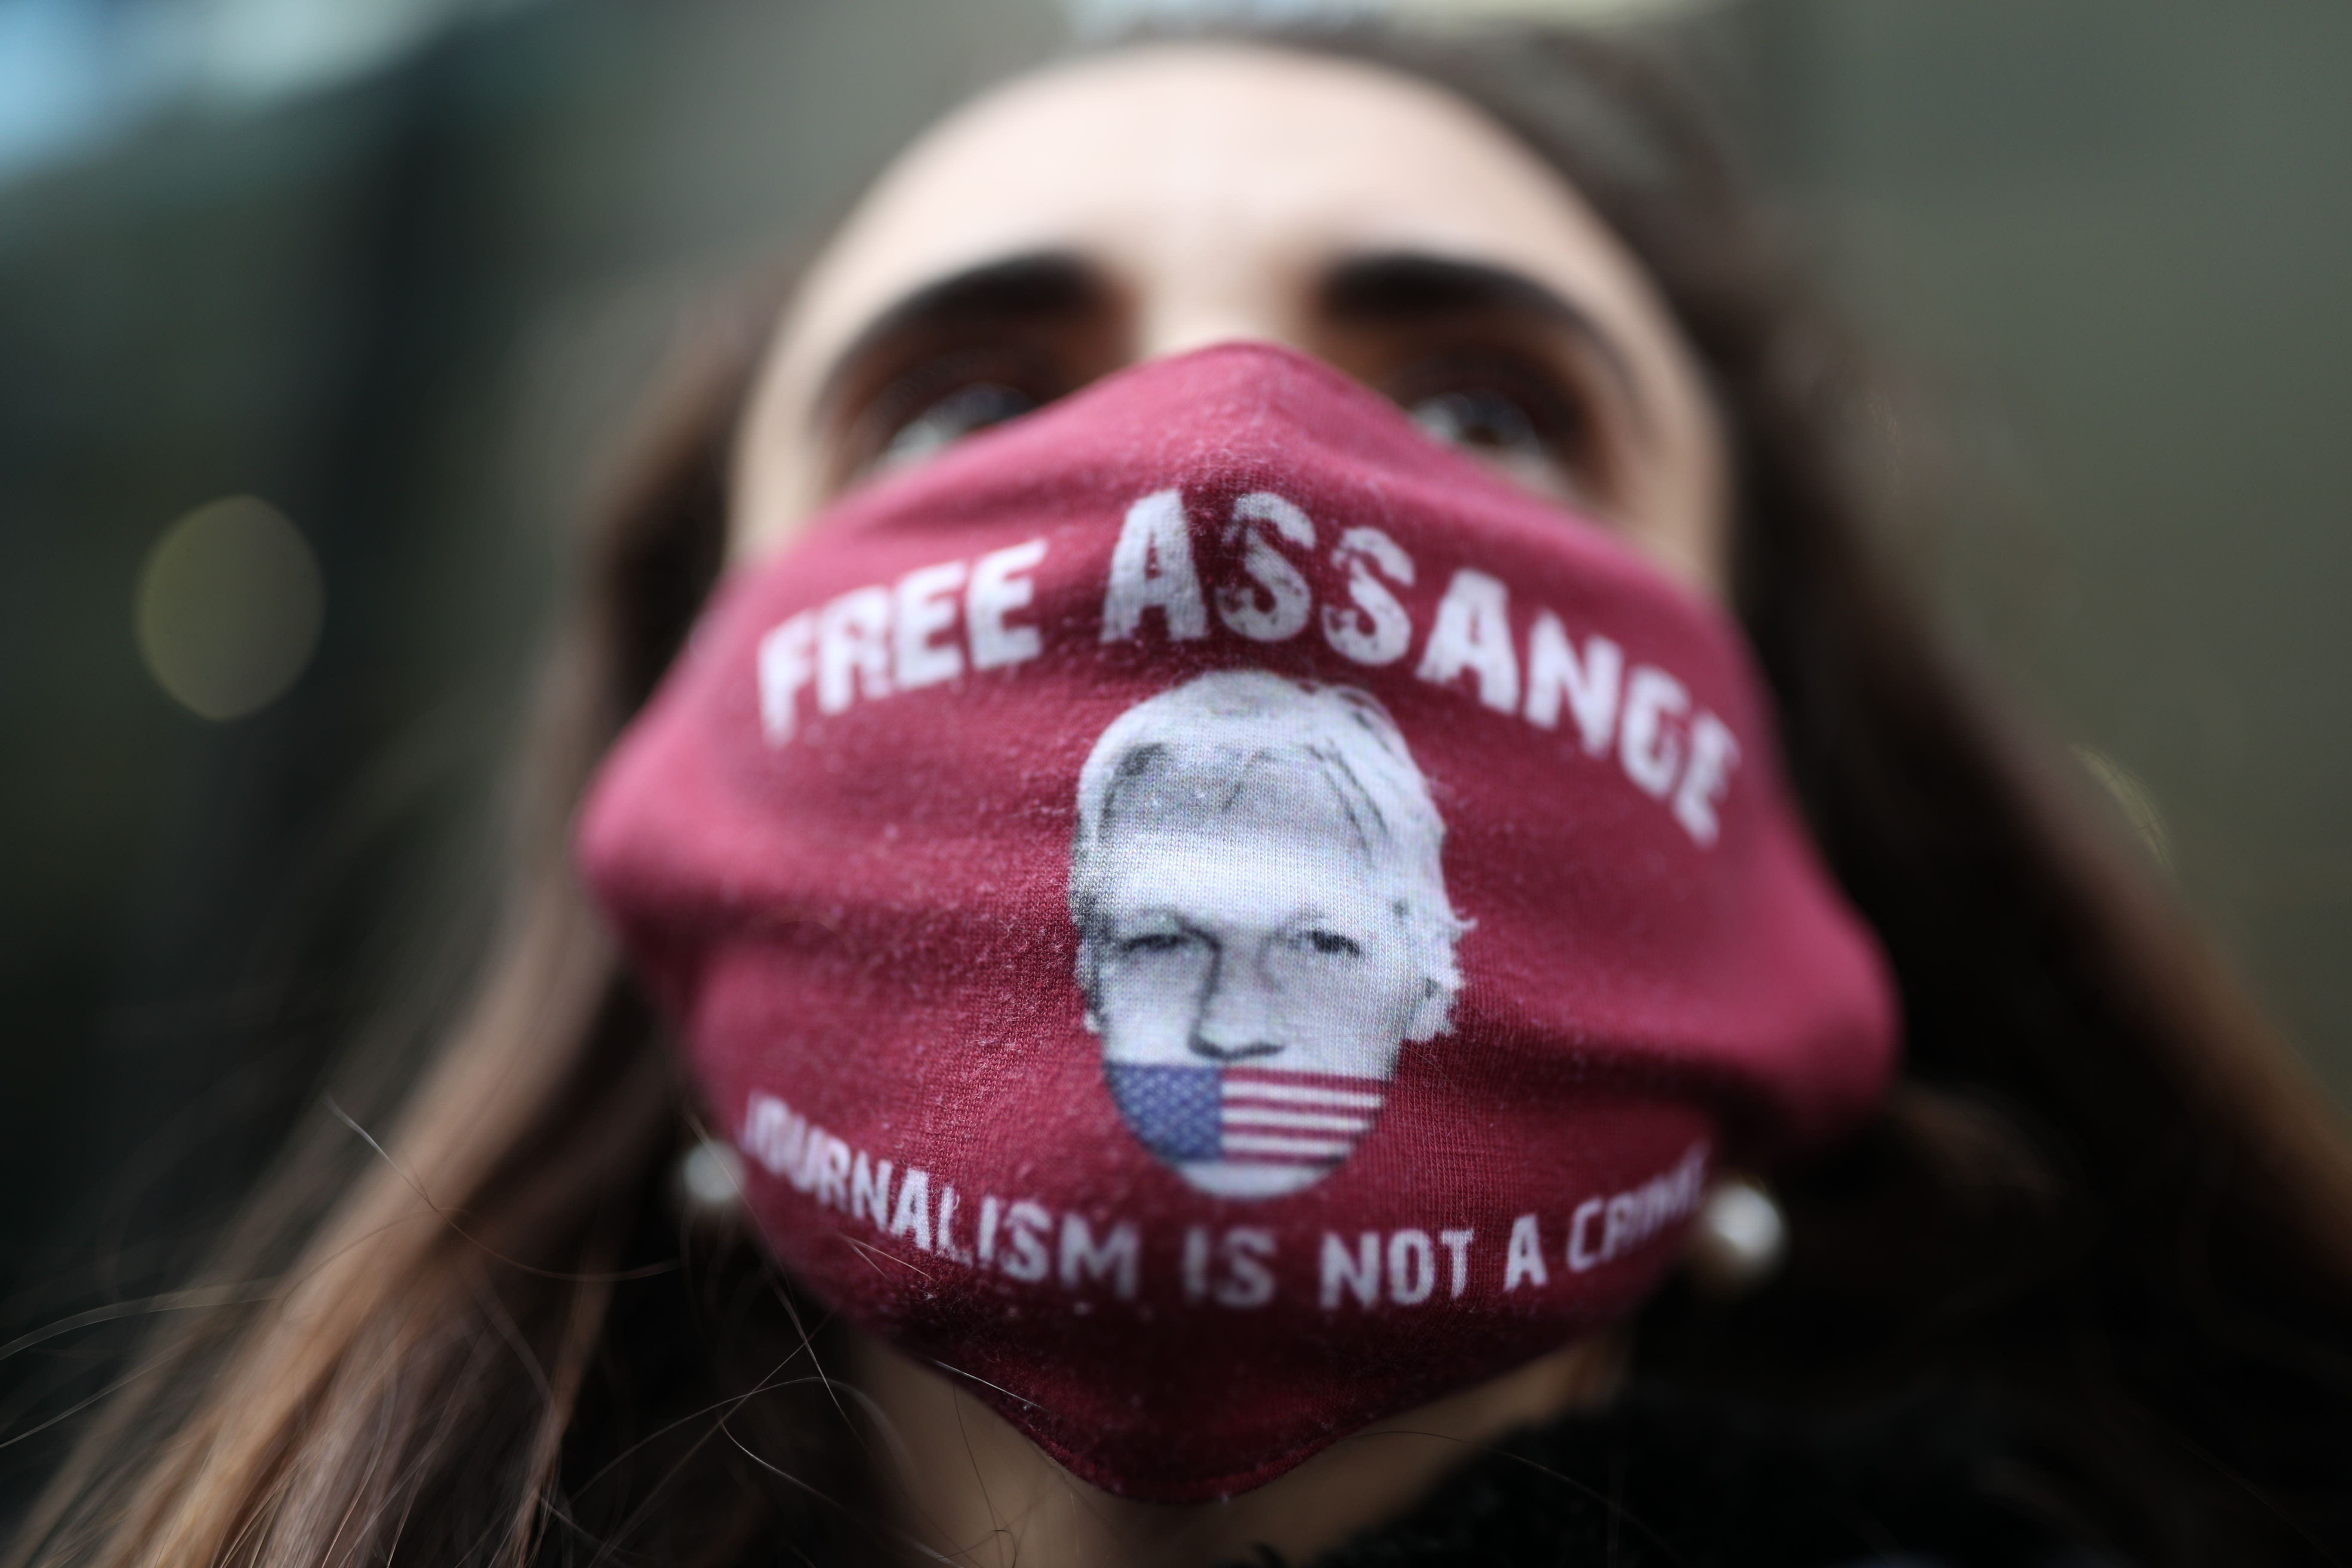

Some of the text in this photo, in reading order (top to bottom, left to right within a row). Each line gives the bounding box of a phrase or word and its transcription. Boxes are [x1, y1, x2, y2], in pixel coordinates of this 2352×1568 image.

[757, 489, 1740, 845] FREE ASSANGE
[1184, 1226, 1275, 1308] IS
[1319, 1228, 1475, 1310] NOT
[1504, 1213, 1547, 1291] A
